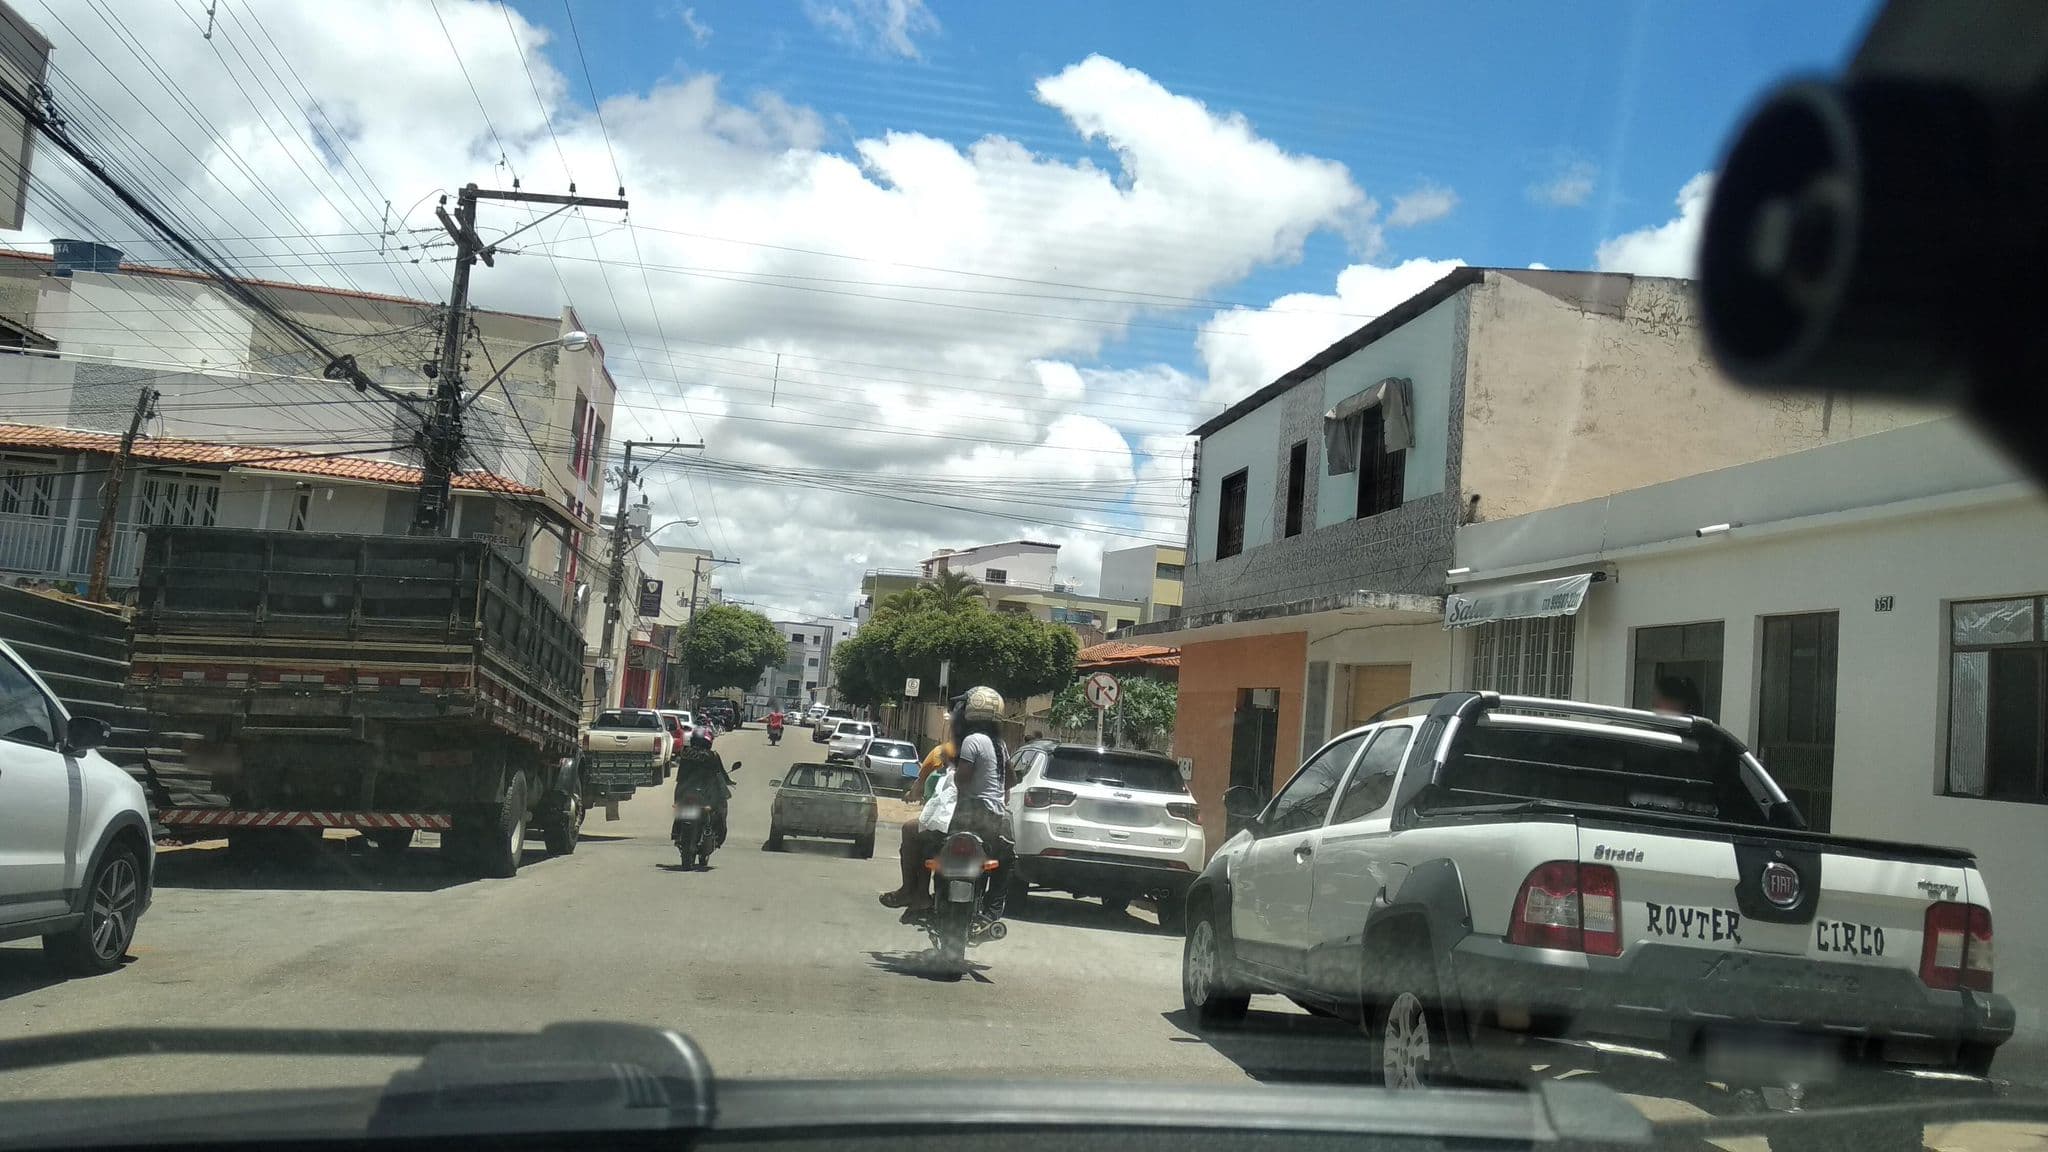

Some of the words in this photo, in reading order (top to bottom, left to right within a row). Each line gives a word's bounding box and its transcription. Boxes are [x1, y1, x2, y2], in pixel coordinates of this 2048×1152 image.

[1594, 844, 1645, 863] Strada
[1769, 874, 1793, 894] FIAT
[1646, 902, 1742, 944] ROYTER
[1816, 921, 1885, 957] CIRCO
